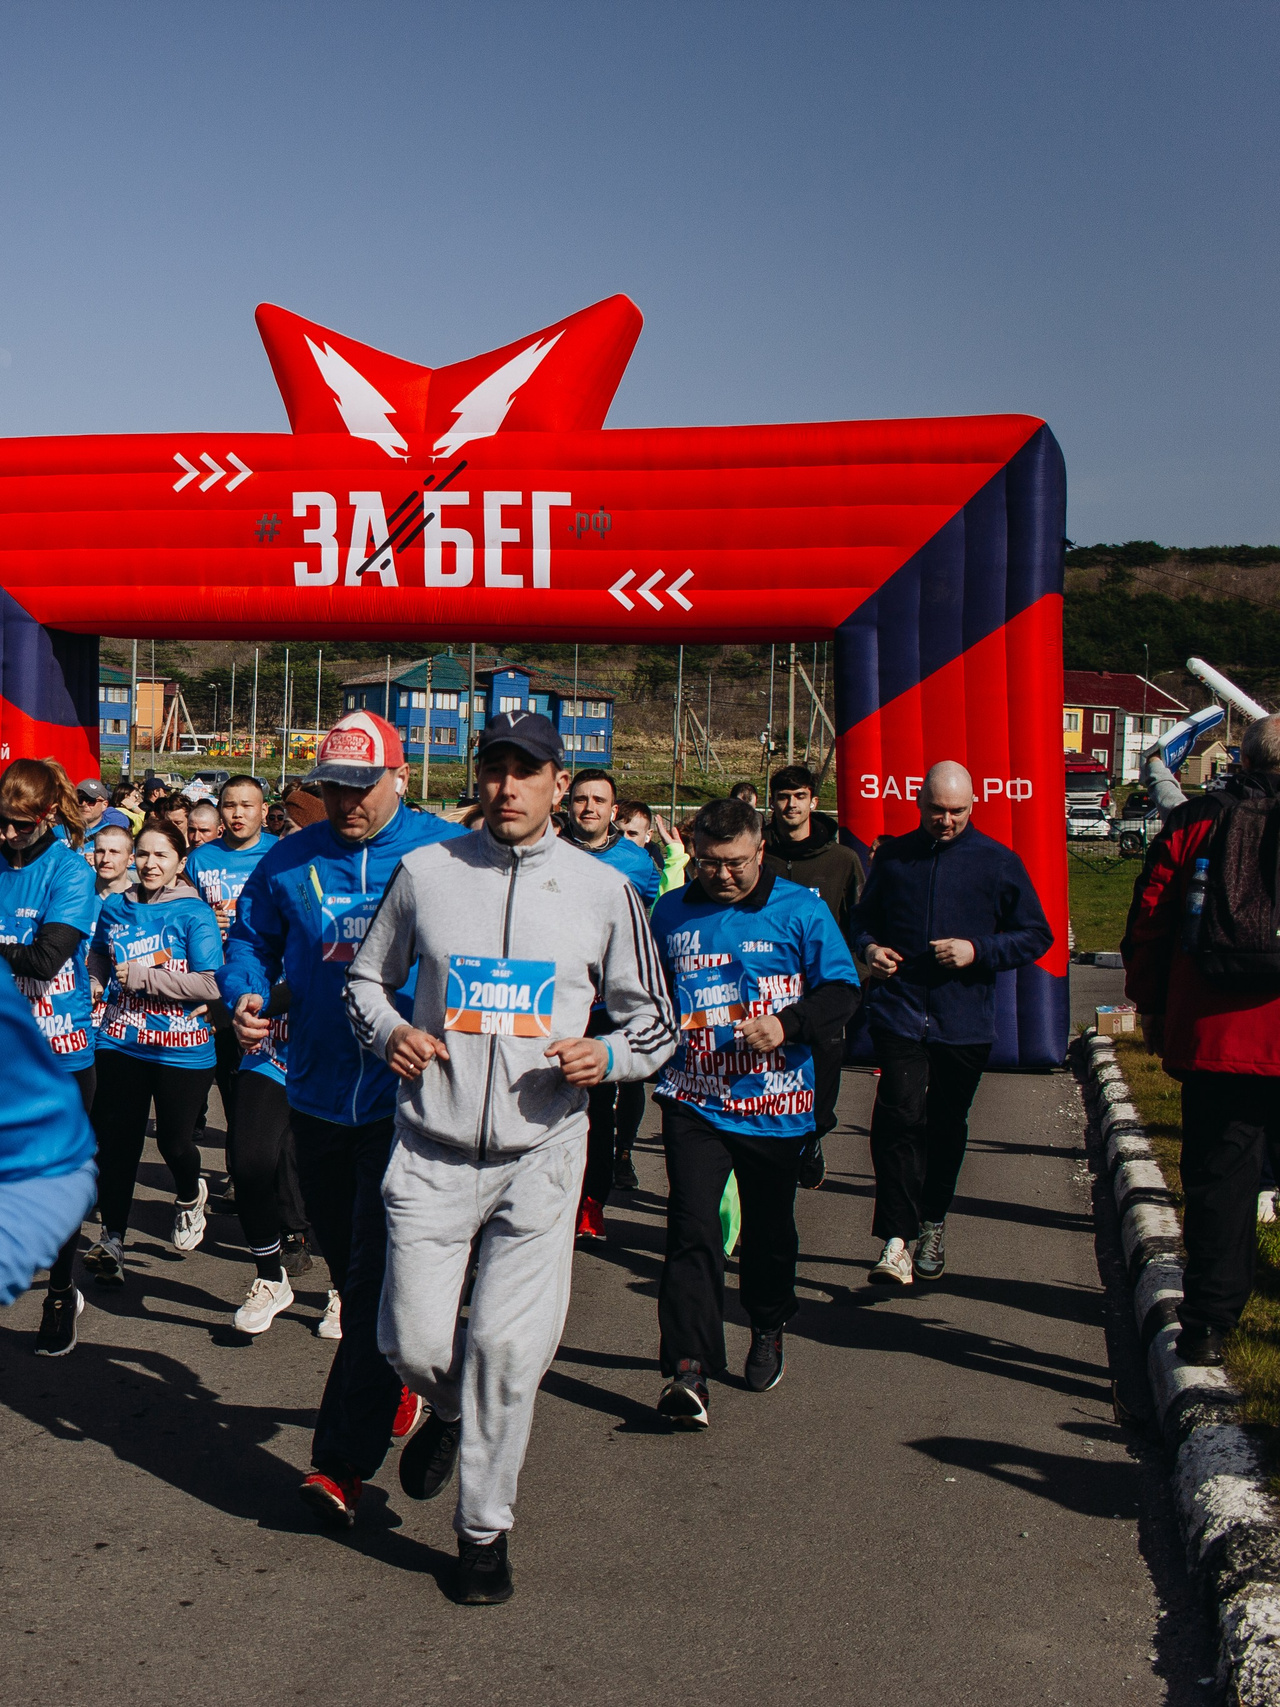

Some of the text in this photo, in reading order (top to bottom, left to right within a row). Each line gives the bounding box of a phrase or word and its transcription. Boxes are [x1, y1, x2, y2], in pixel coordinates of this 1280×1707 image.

[127, 934, 160, 958] 20027
[666, 930, 701, 957] 2024
[469, 981, 532, 1011] 20014
[694, 982, 739, 1009] 20035
[169, 1015, 200, 1032] 2024
[480, 1011, 515, 1035] 5КМ
[706, 1006, 731, 1027] 5КМ
[49, 1028, 89, 1054] СТВО
[137, 1027, 210, 1047] #ЕДИНСТВО
[684, 1049, 787, 1075] #ГОРДОСТЬ
[763, 1069, 805, 1094] 2024
[721, 1088, 815, 1117] #ЕДИНСТВО
